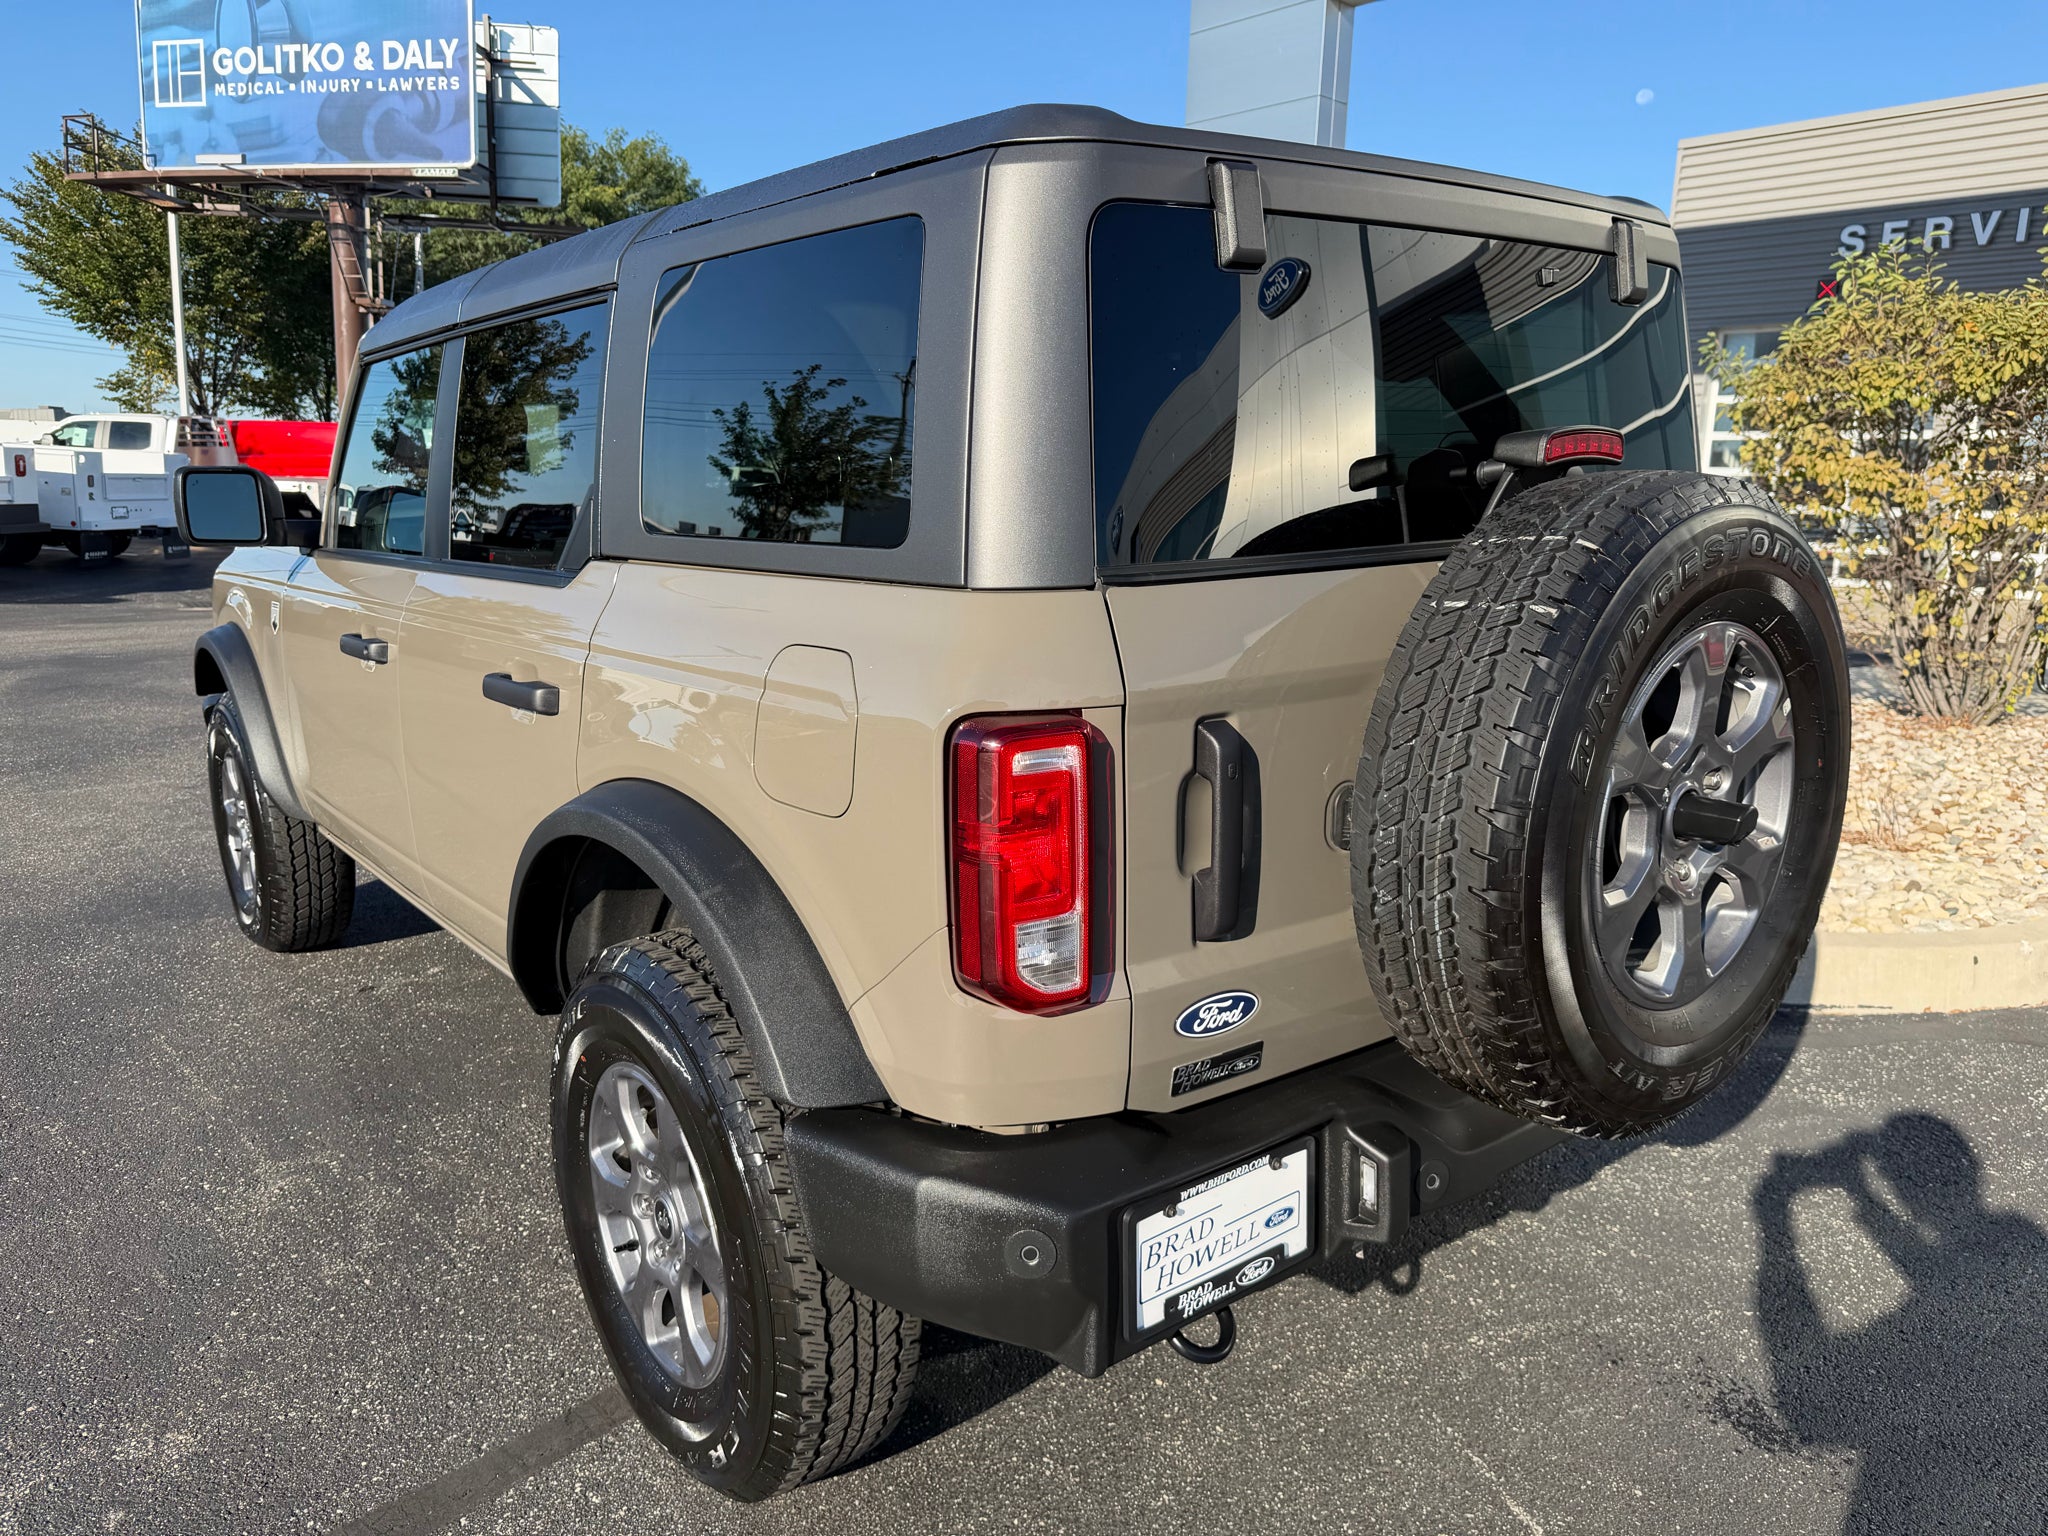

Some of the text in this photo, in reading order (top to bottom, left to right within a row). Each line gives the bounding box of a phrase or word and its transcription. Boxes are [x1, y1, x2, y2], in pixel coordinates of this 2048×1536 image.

[213, 38, 459, 76] GOLITKO & DALY
[214, 76, 460, 97] MEDICAL INJURY LAWYERS
[1567, 526, 1812, 793] BRIDGESTONE
[1193, 998, 1246, 1033] Ford
[1174, 1059, 1212, 1085] BRAD
[1178, 1064, 1229, 1094] HOWELL
[1179, 1154, 1271, 1202] WWW.BHIFORD.COM
[1144, 1217, 1215, 1272] BRAD
[1155, 1220, 1261, 1293] HOWELL
[1177, 1281, 1214, 1310] BRAD
[1183, 1280, 1237, 1319] HOWELL
